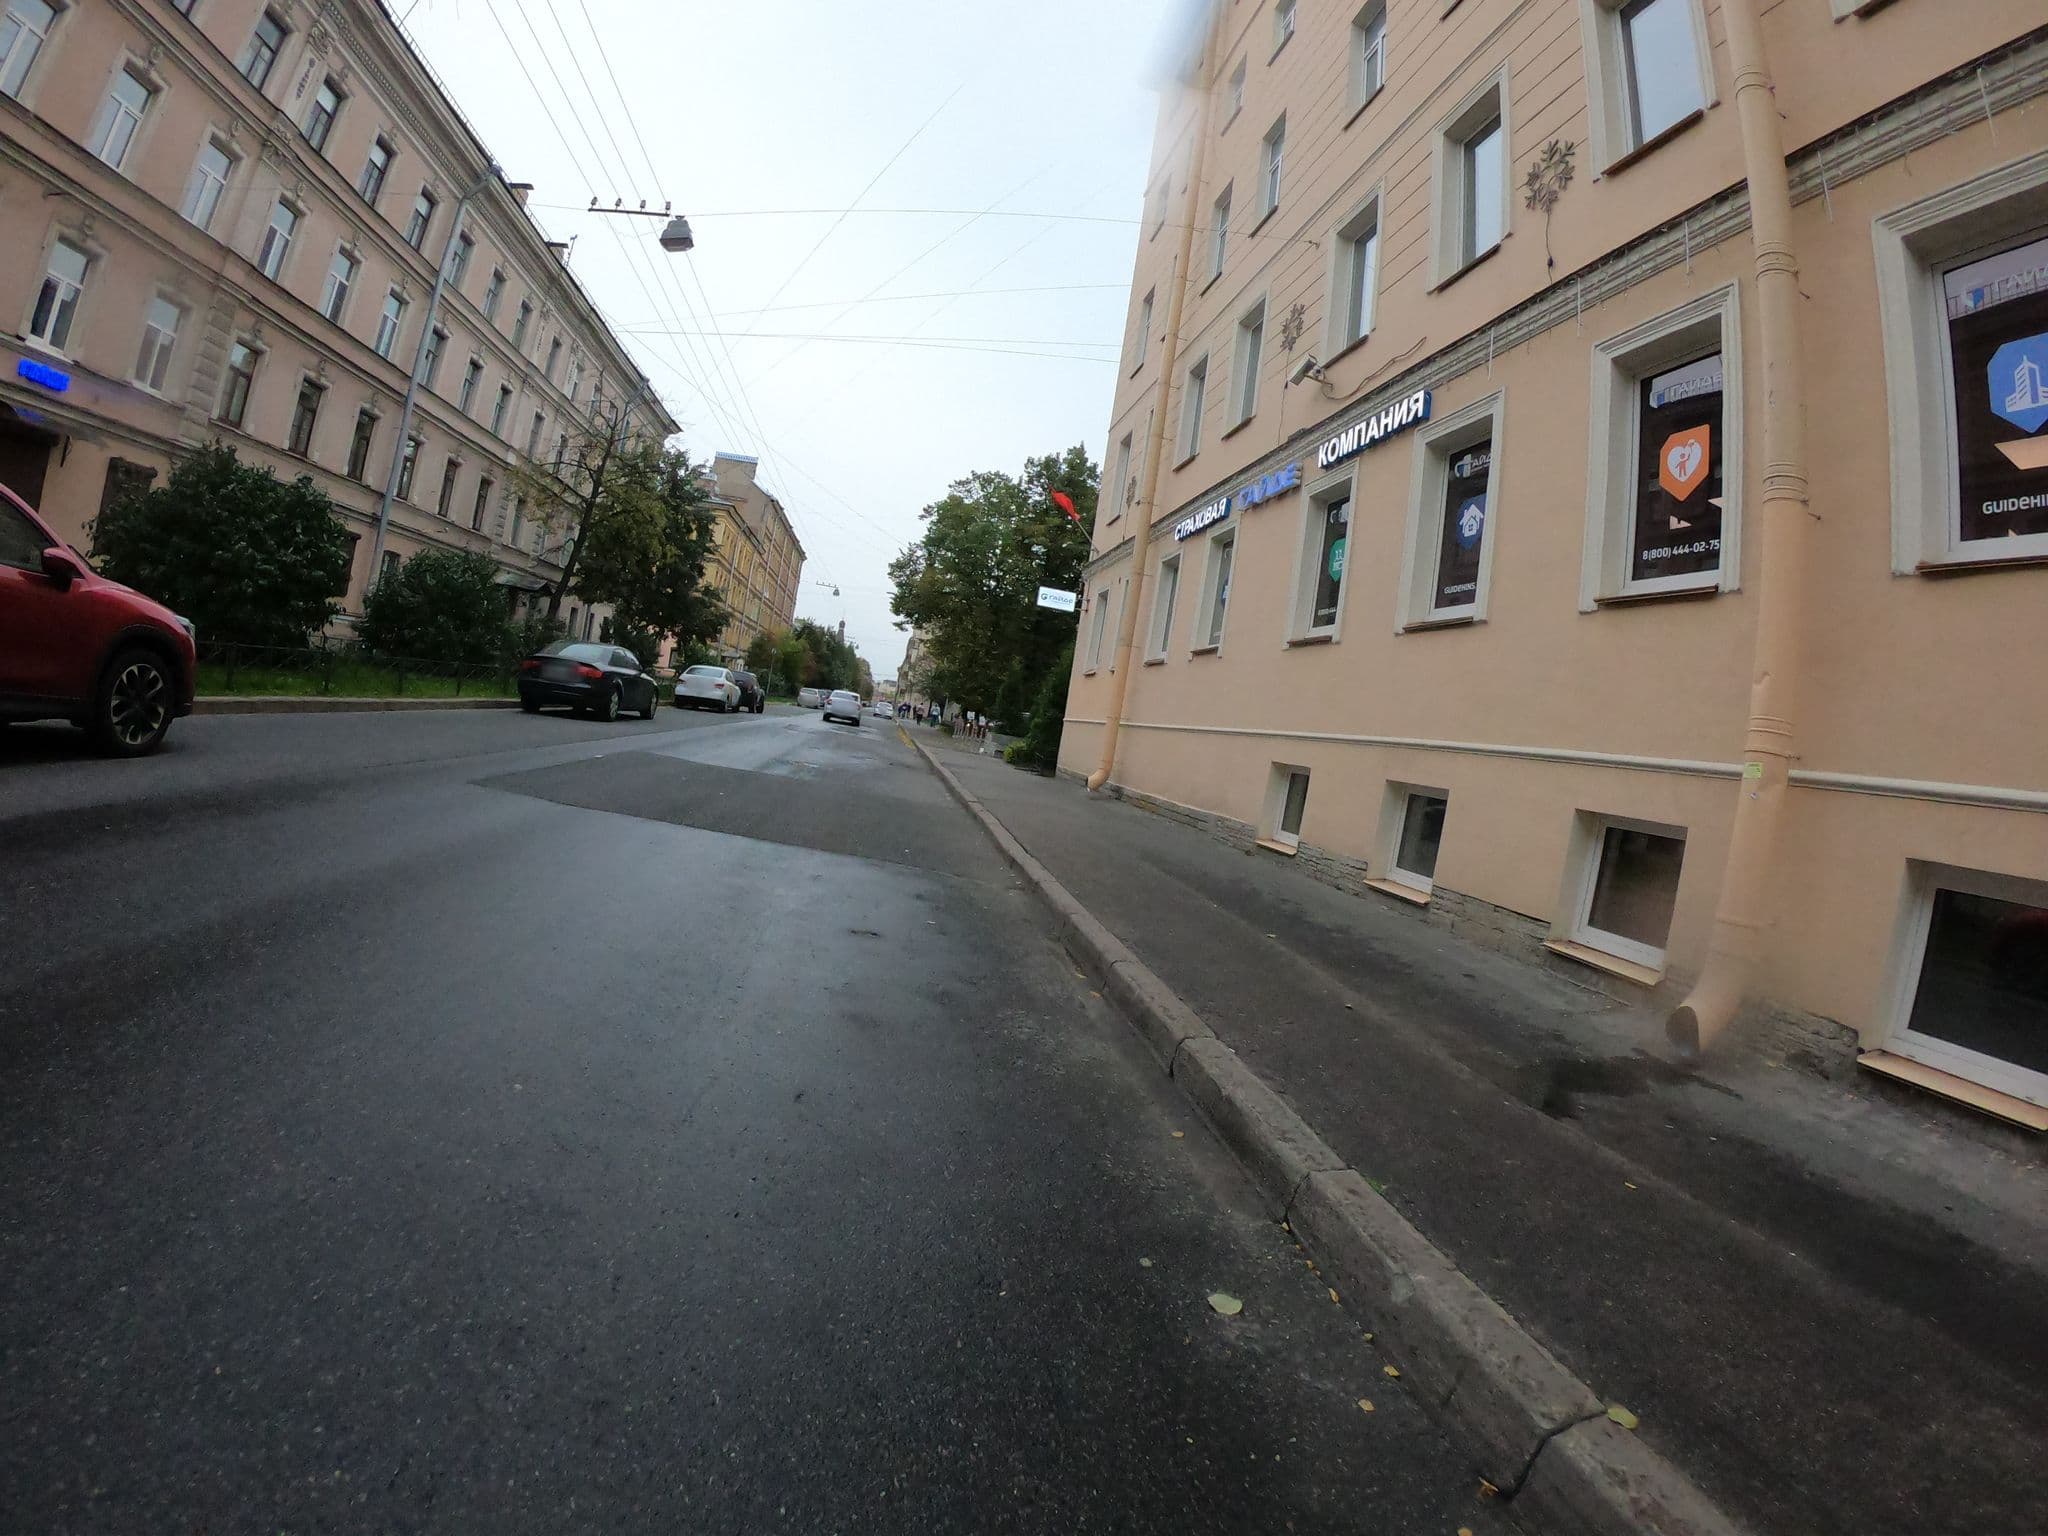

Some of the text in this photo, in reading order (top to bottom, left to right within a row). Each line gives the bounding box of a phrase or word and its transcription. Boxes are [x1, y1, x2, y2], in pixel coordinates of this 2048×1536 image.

[1317, 389, 1425, 468] КОМПАНИЯ
[1174, 497, 1227, 541] СТРАХОВАЯ
[1642, 539, 1720, 560] 8(800) 444-02-75
